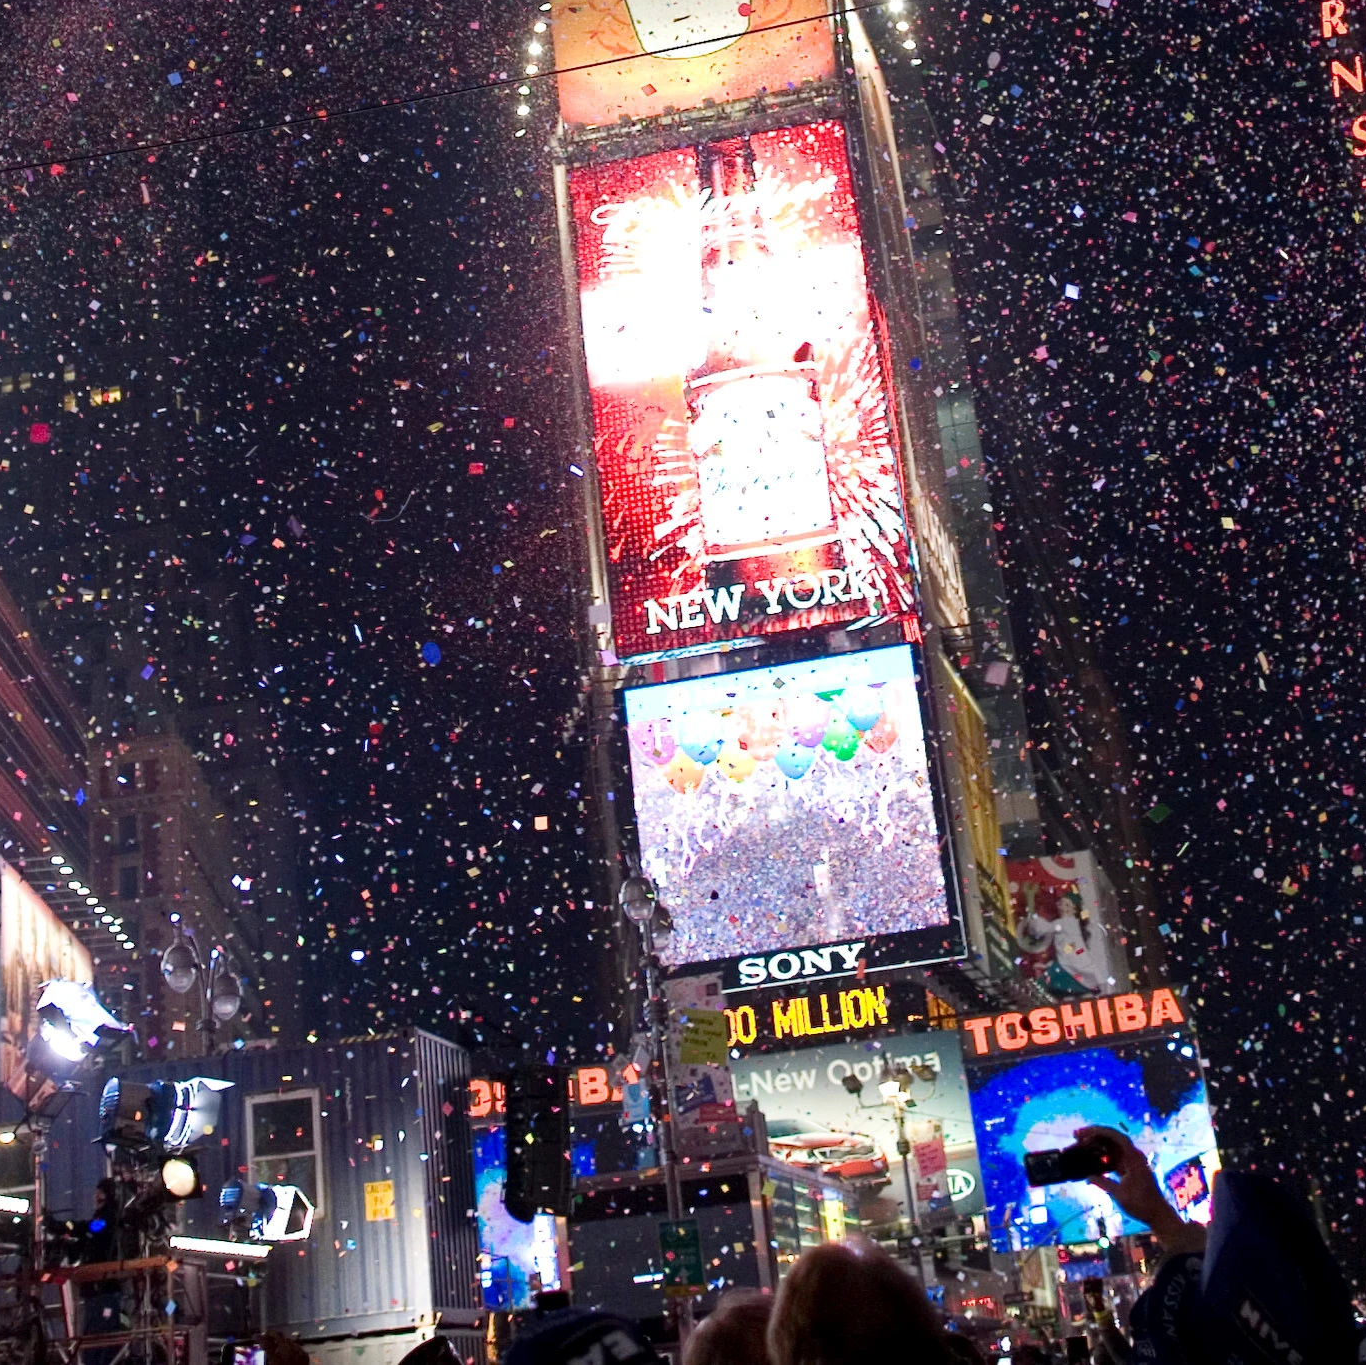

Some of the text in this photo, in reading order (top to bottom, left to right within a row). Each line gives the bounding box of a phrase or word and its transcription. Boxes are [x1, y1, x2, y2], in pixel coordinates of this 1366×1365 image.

[644, 565, 881, 635] NEW YORK
[737, 941, 867, 986] SONY
[771, 985, 889, 1040] MILLION
[963, 987, 1185, 1055] TOSHIBA
